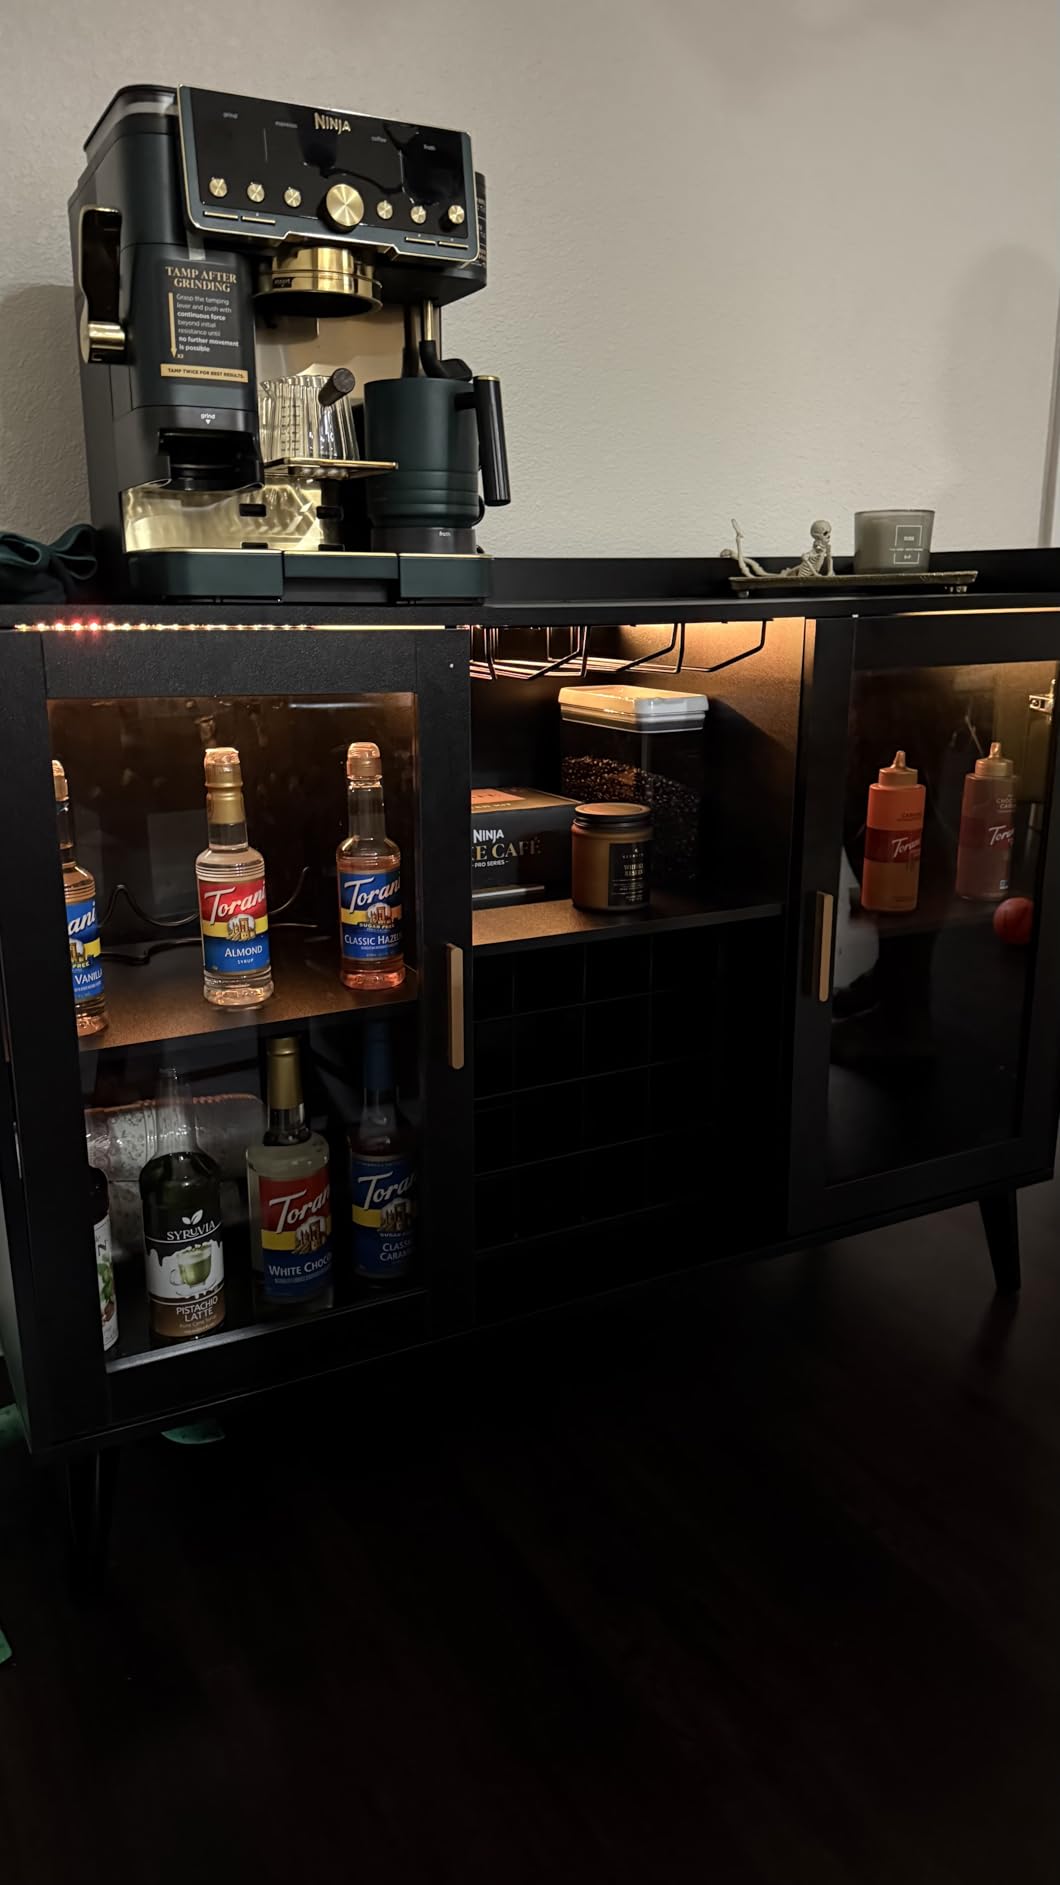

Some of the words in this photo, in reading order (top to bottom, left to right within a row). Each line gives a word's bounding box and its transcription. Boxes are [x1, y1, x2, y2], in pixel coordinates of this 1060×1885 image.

[313, 111, 352, 135] NINJA
[165, 266, 199, 278] TAMP
[201, 270, 237, 284] AFTER
[173, 278, 231, 293] GRINDING
[176, 293, 194, 302] Grasp
[205, 297, 230, 306] tamping
[177, 311, 210, 319] continuous
[210, 313, 226, 321] force
[177, 319, 200, 327] beyond
[185, 345, 210, 353] possible
[187, 336, 208, 344] further
[209, 340, 239, 348] movement
[472, 829, 504, 844] NINJA
[486, 859, 505, 867] SERIES
[344, 934, 376, 946] CLASSIC
[224, 944, 263, 958] ALMOND
[166, 1219, 217, 1241] SYRUVIA
[268, 1263, 302, 1277] WHITE
[176, 1295, 219, 1316] PISTACHIO
[184, 1306, 214, 1323] LATTE
